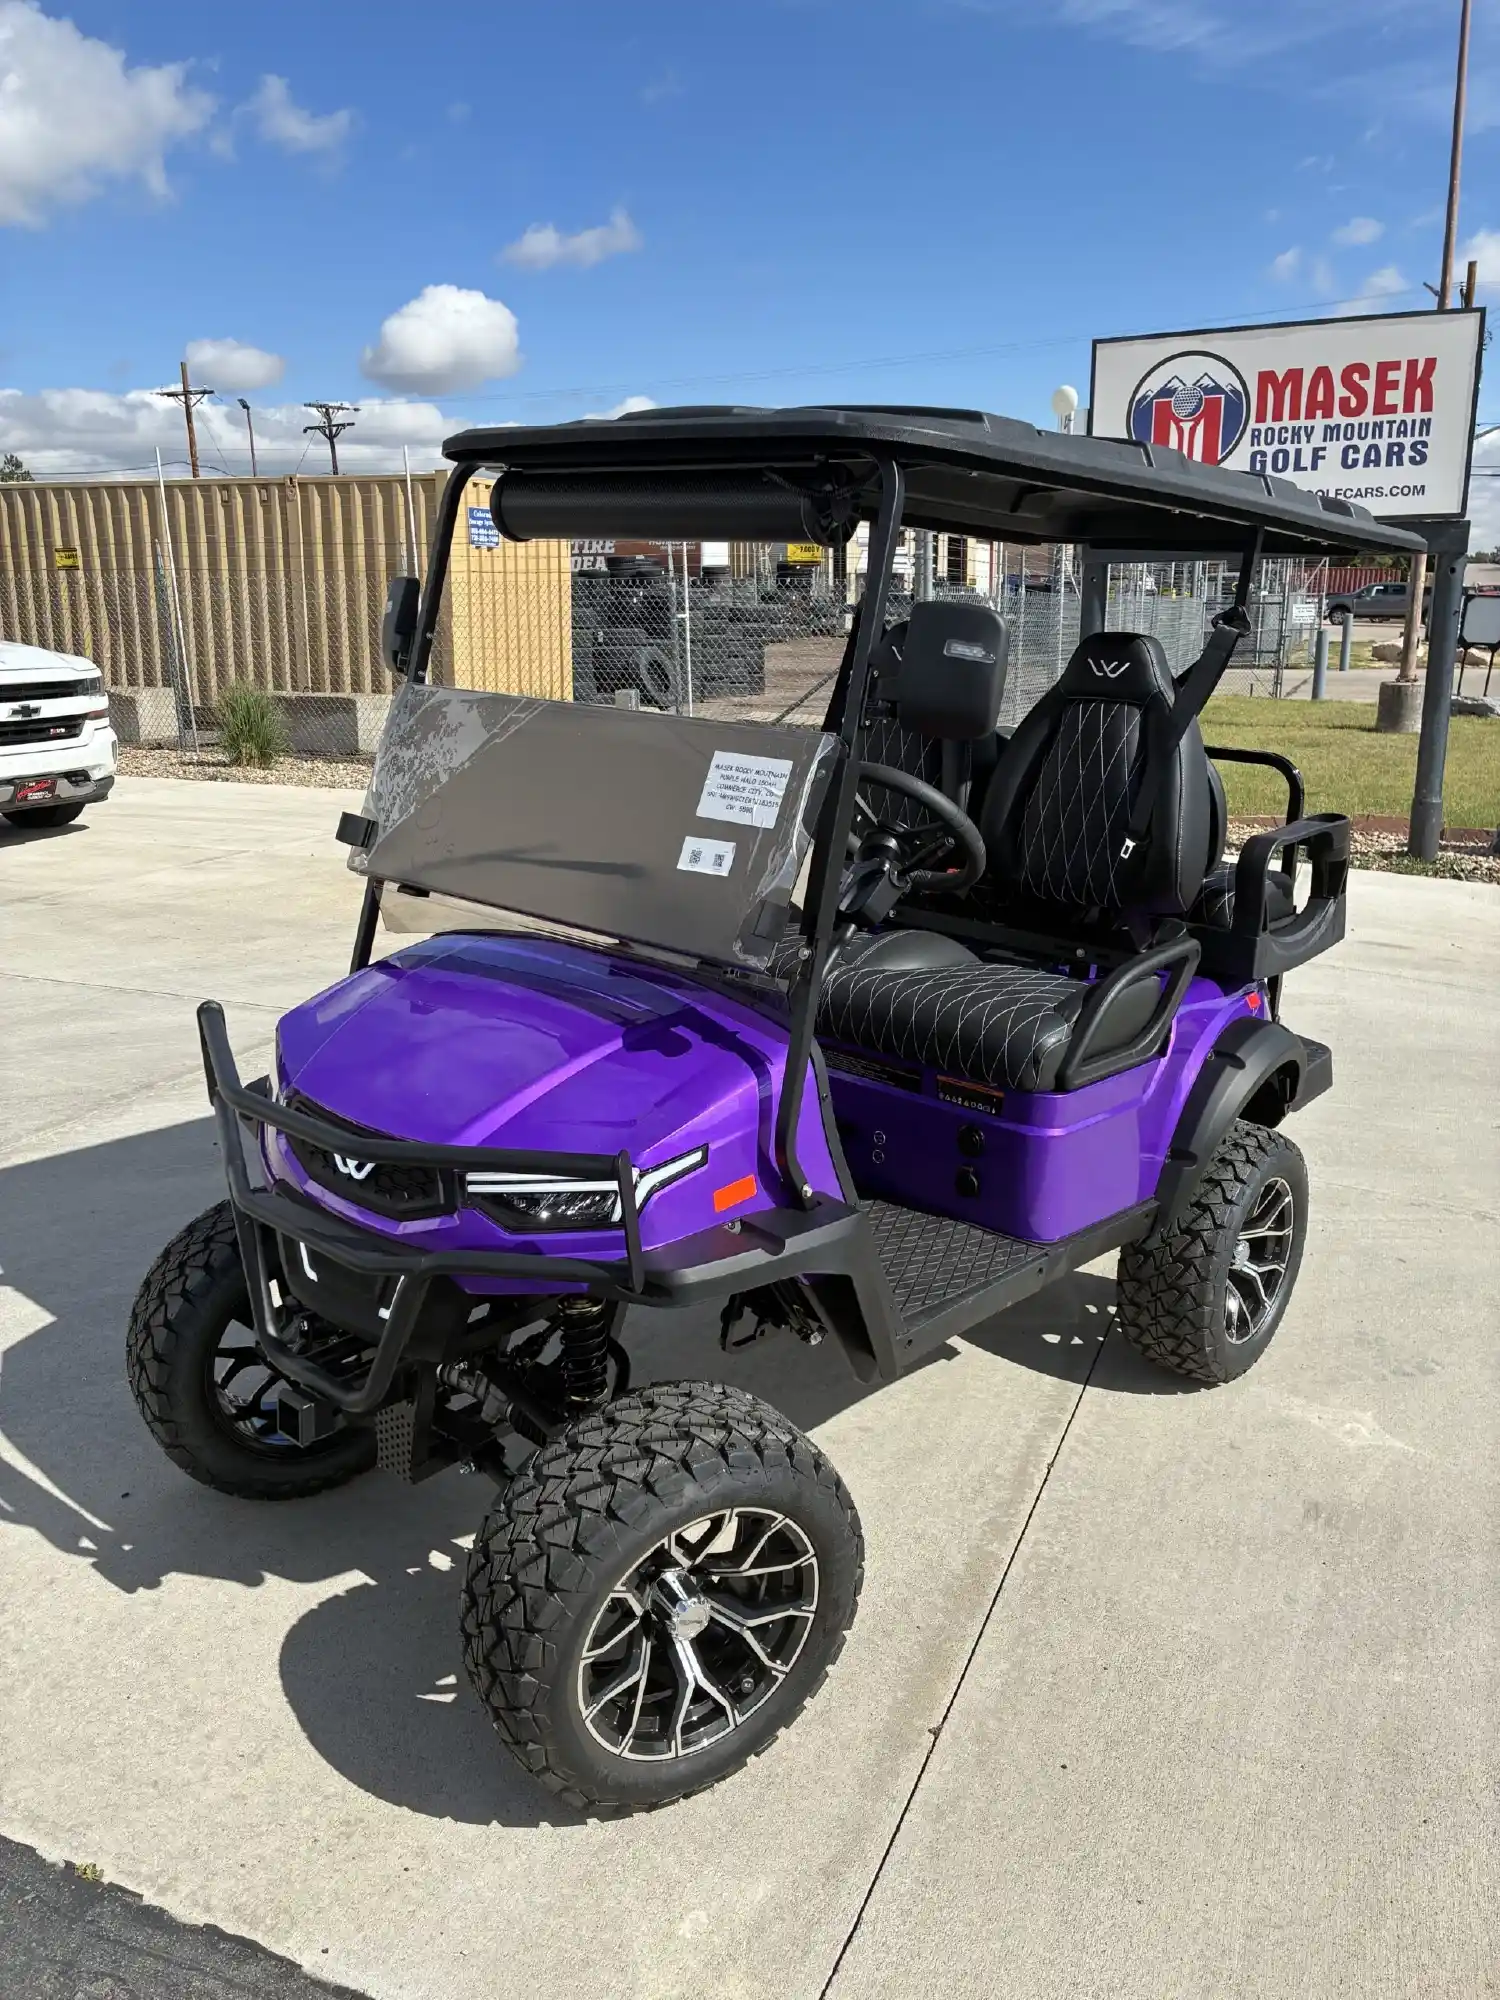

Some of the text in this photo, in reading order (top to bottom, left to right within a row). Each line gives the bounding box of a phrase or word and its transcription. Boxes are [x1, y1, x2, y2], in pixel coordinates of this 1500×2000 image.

[1255, 357, 1437, 423] MASEK
[1250, 417, 1432, 447] ROCKY MOUNTAIN
[1250, 440, 1429, 473] GOLF CARS
[571, 539, 614, 554] TIRE
[571, 556, 608, 572] DEA
